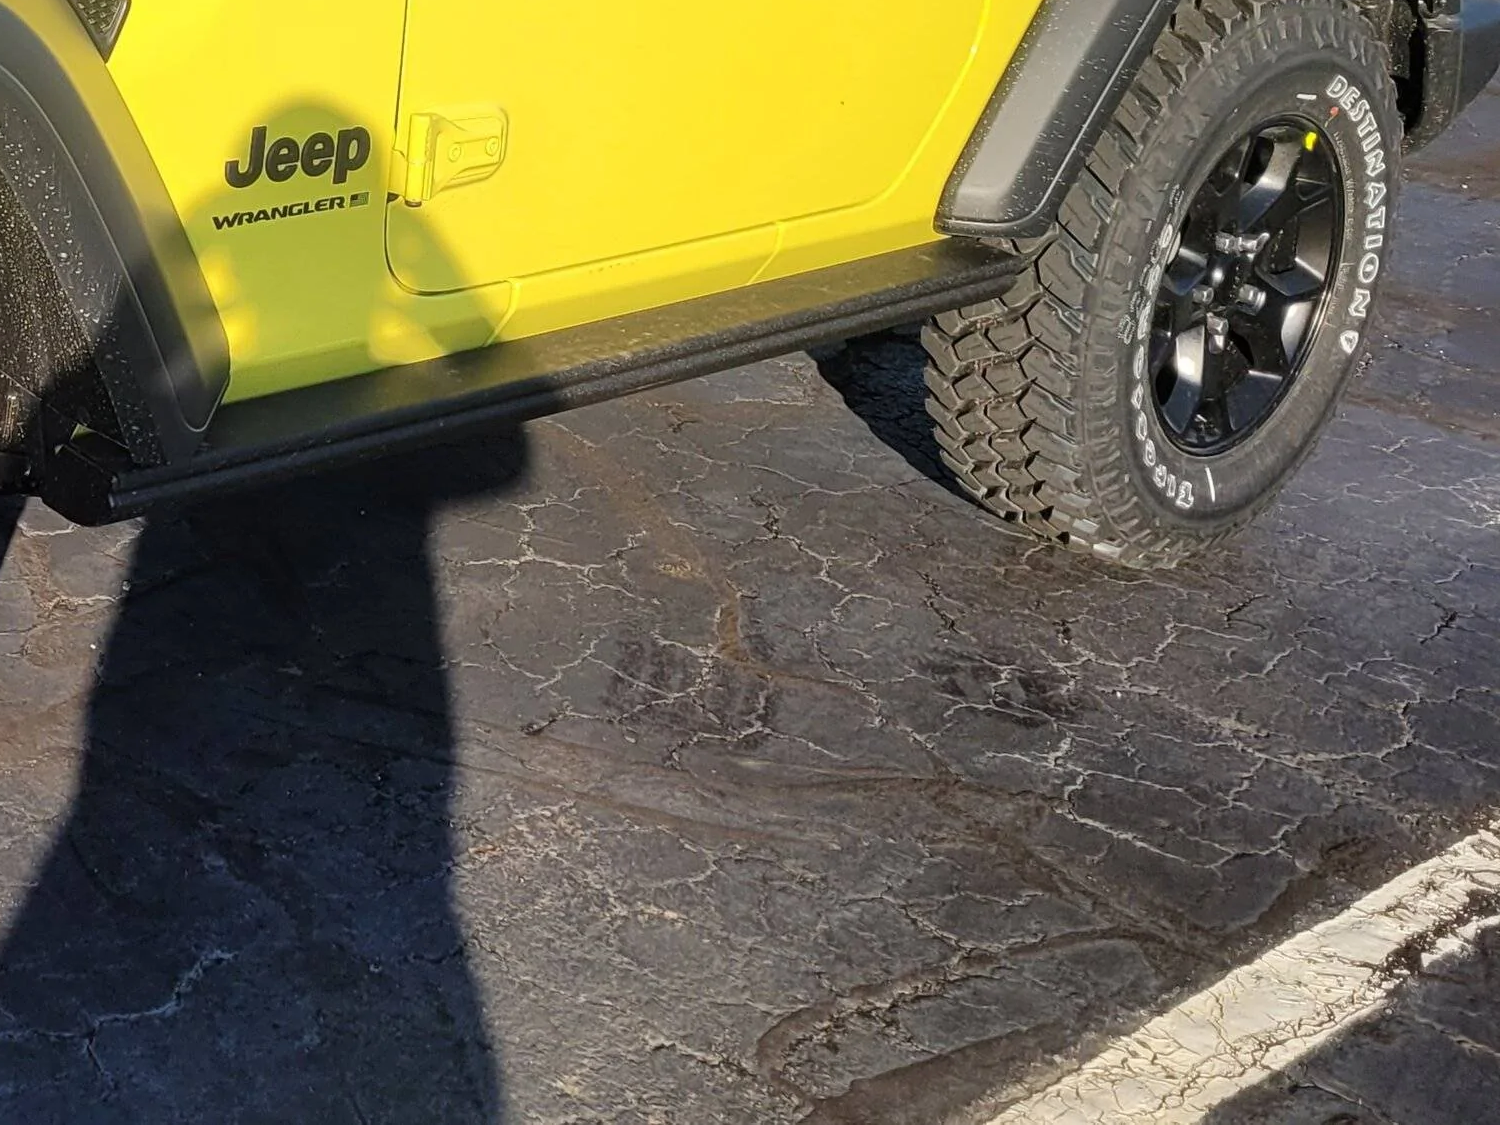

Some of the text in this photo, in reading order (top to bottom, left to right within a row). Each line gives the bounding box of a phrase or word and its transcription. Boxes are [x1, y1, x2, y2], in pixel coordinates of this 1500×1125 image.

[224, 125, 371, 189] Jeep
[212, 195, 346, 231] WRANGLER
[1325, 74, 1387, 318] DESTINATION
